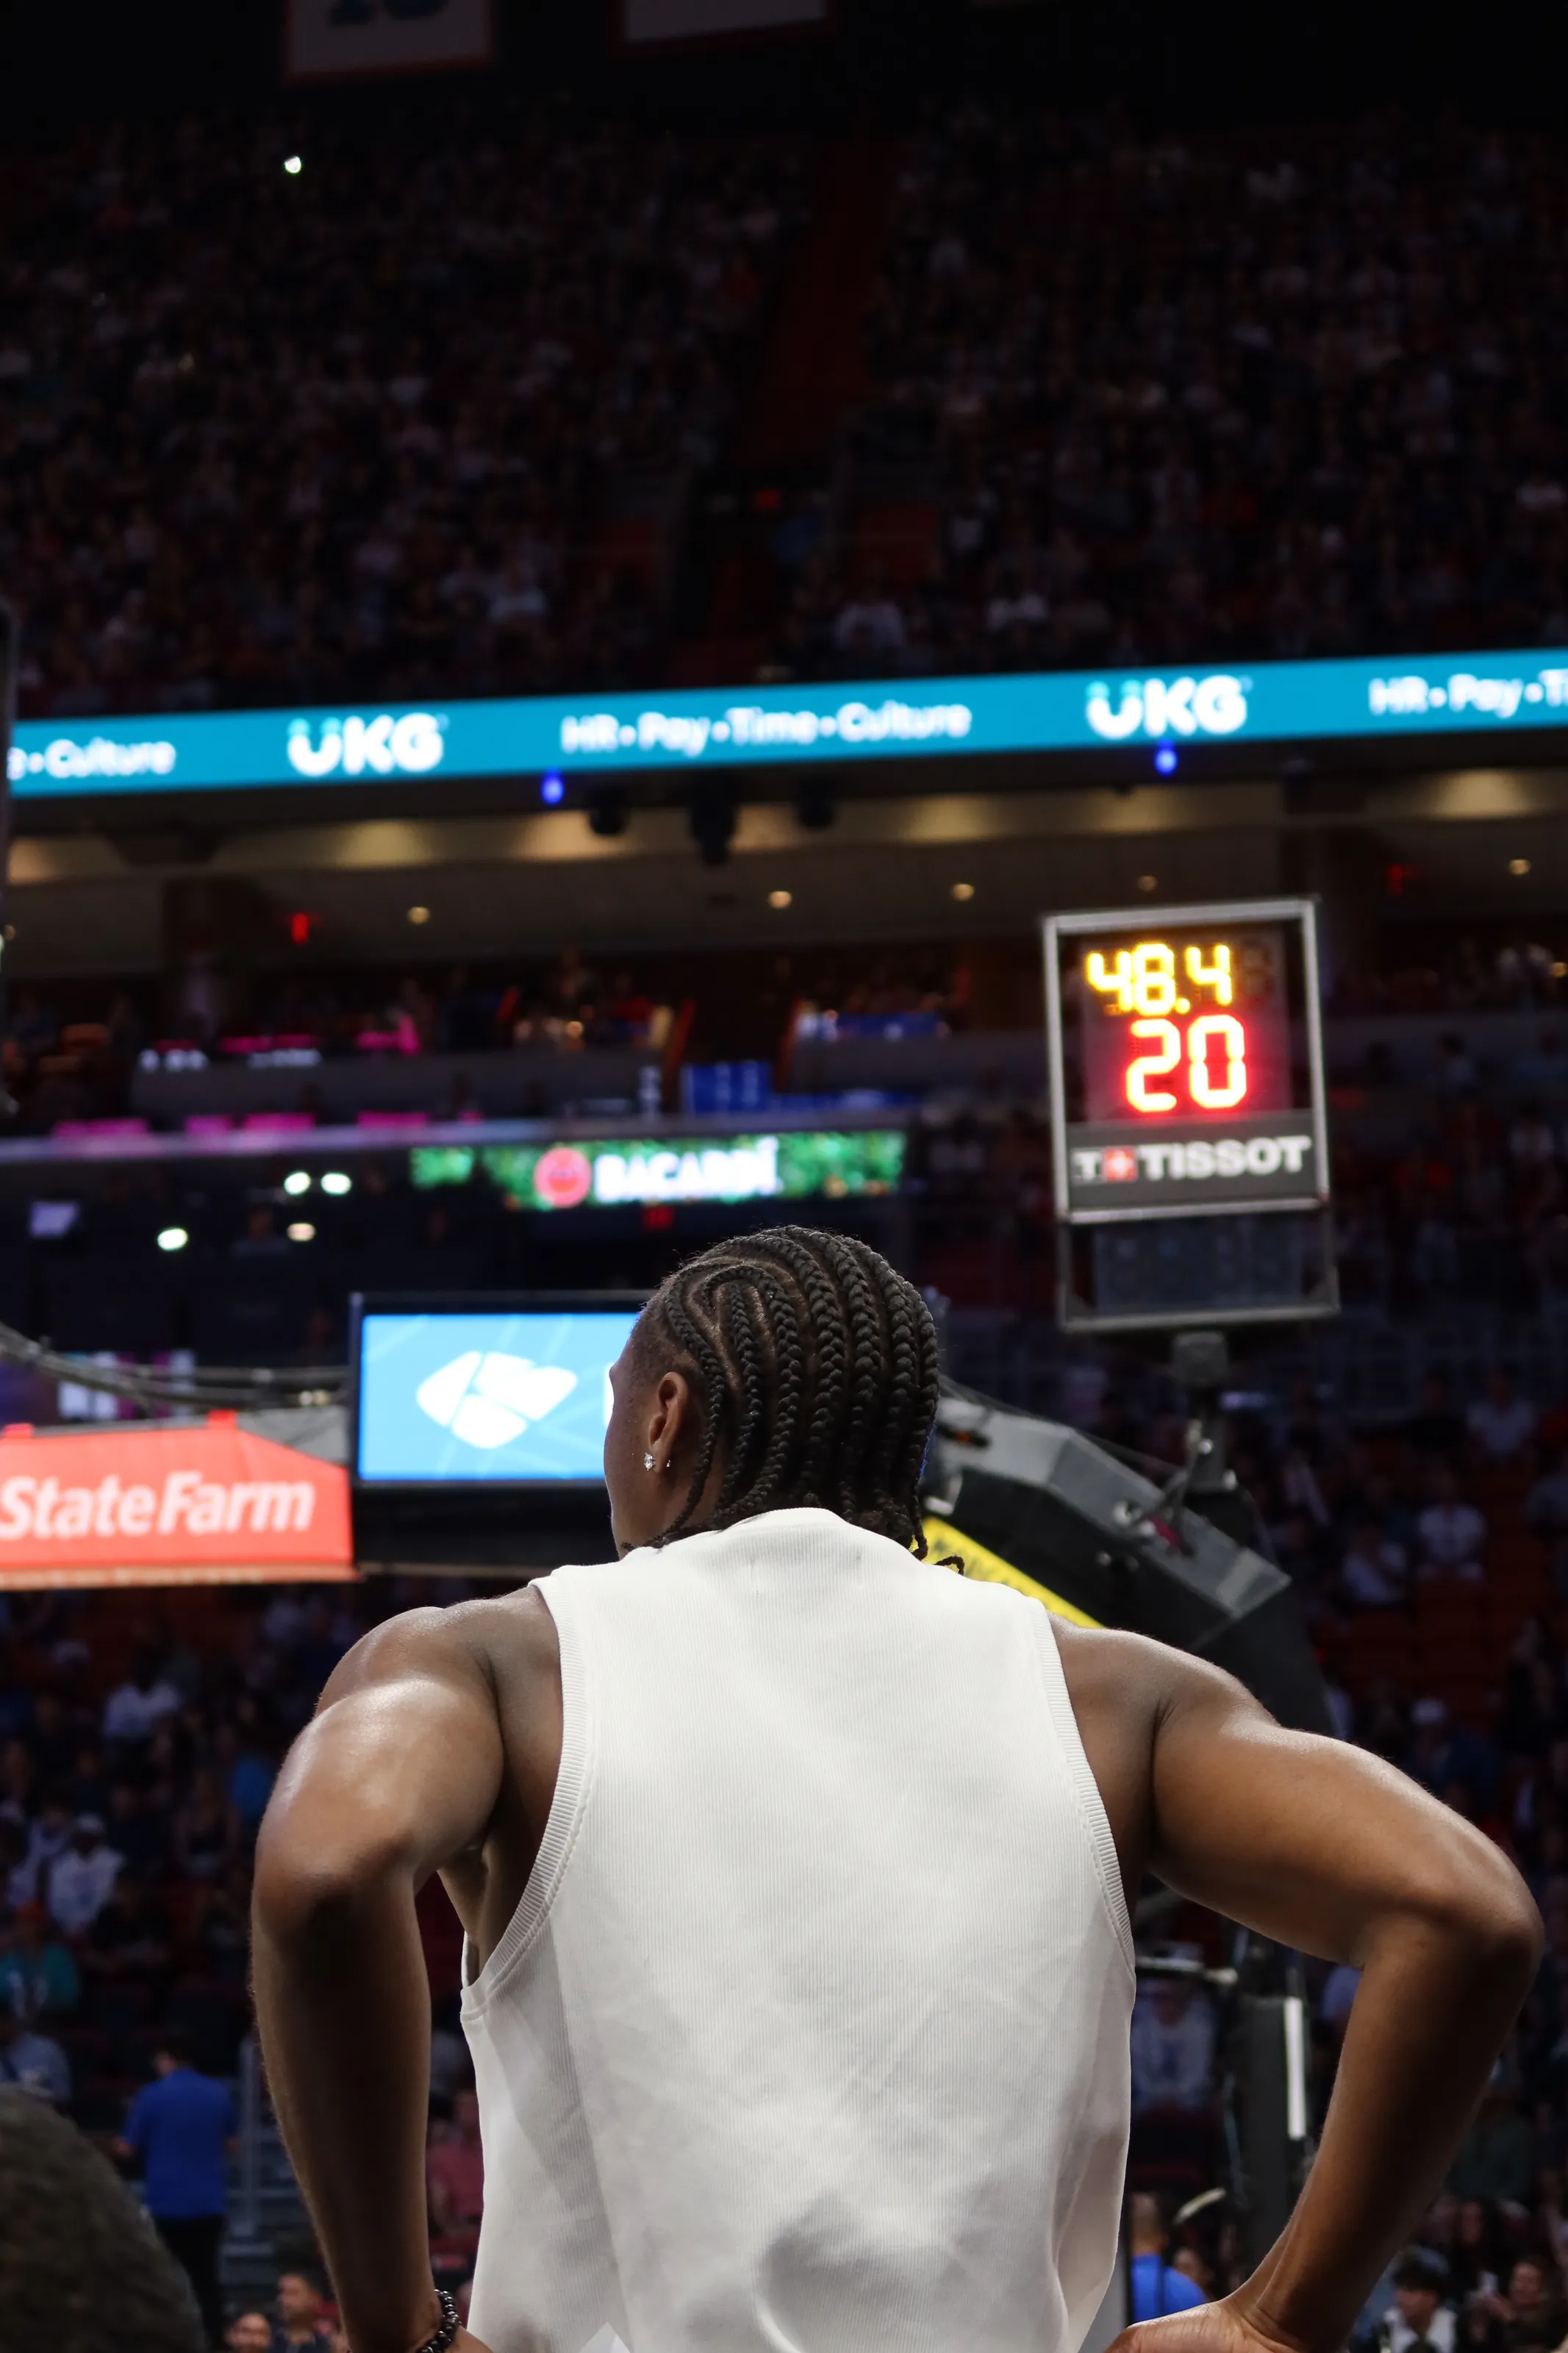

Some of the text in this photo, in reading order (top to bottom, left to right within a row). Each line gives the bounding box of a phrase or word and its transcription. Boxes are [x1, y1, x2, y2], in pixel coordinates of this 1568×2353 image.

[1086, 674, 1247, 739] UKG
[287, 713, 443, 776] UKG
[1086, 942, 1233, 1015] 48.4
[1125, 1015, 1247, 1112] 20
[1140, 1135, 1312, 1180] TISSOT
